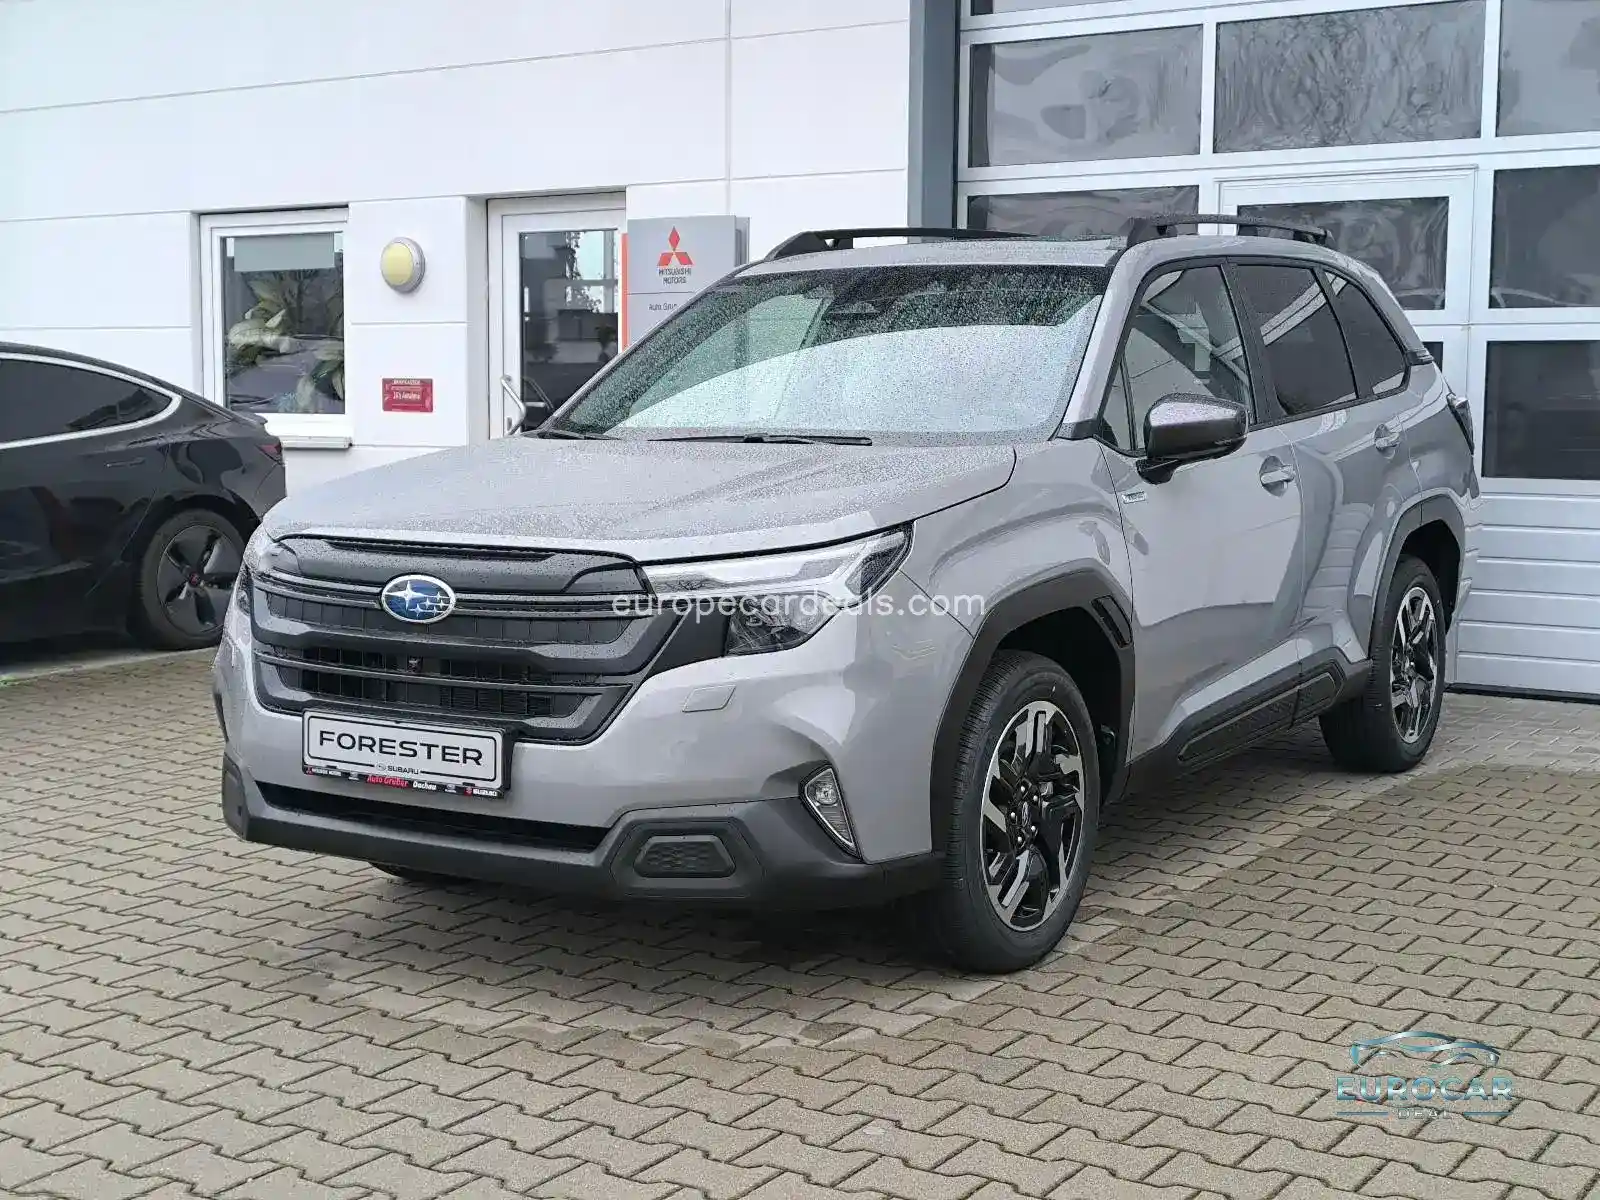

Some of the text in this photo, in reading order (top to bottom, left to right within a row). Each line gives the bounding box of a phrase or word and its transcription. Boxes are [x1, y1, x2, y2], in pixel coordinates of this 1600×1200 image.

[662, 276, 687, 285] MOTORS
[319, 729, 484, 767] FORESTER
[387, 765, 419, 775] SUBARU
[366, 774, 383, 784] Auto
[412, 780, 437, 791] Dachau
